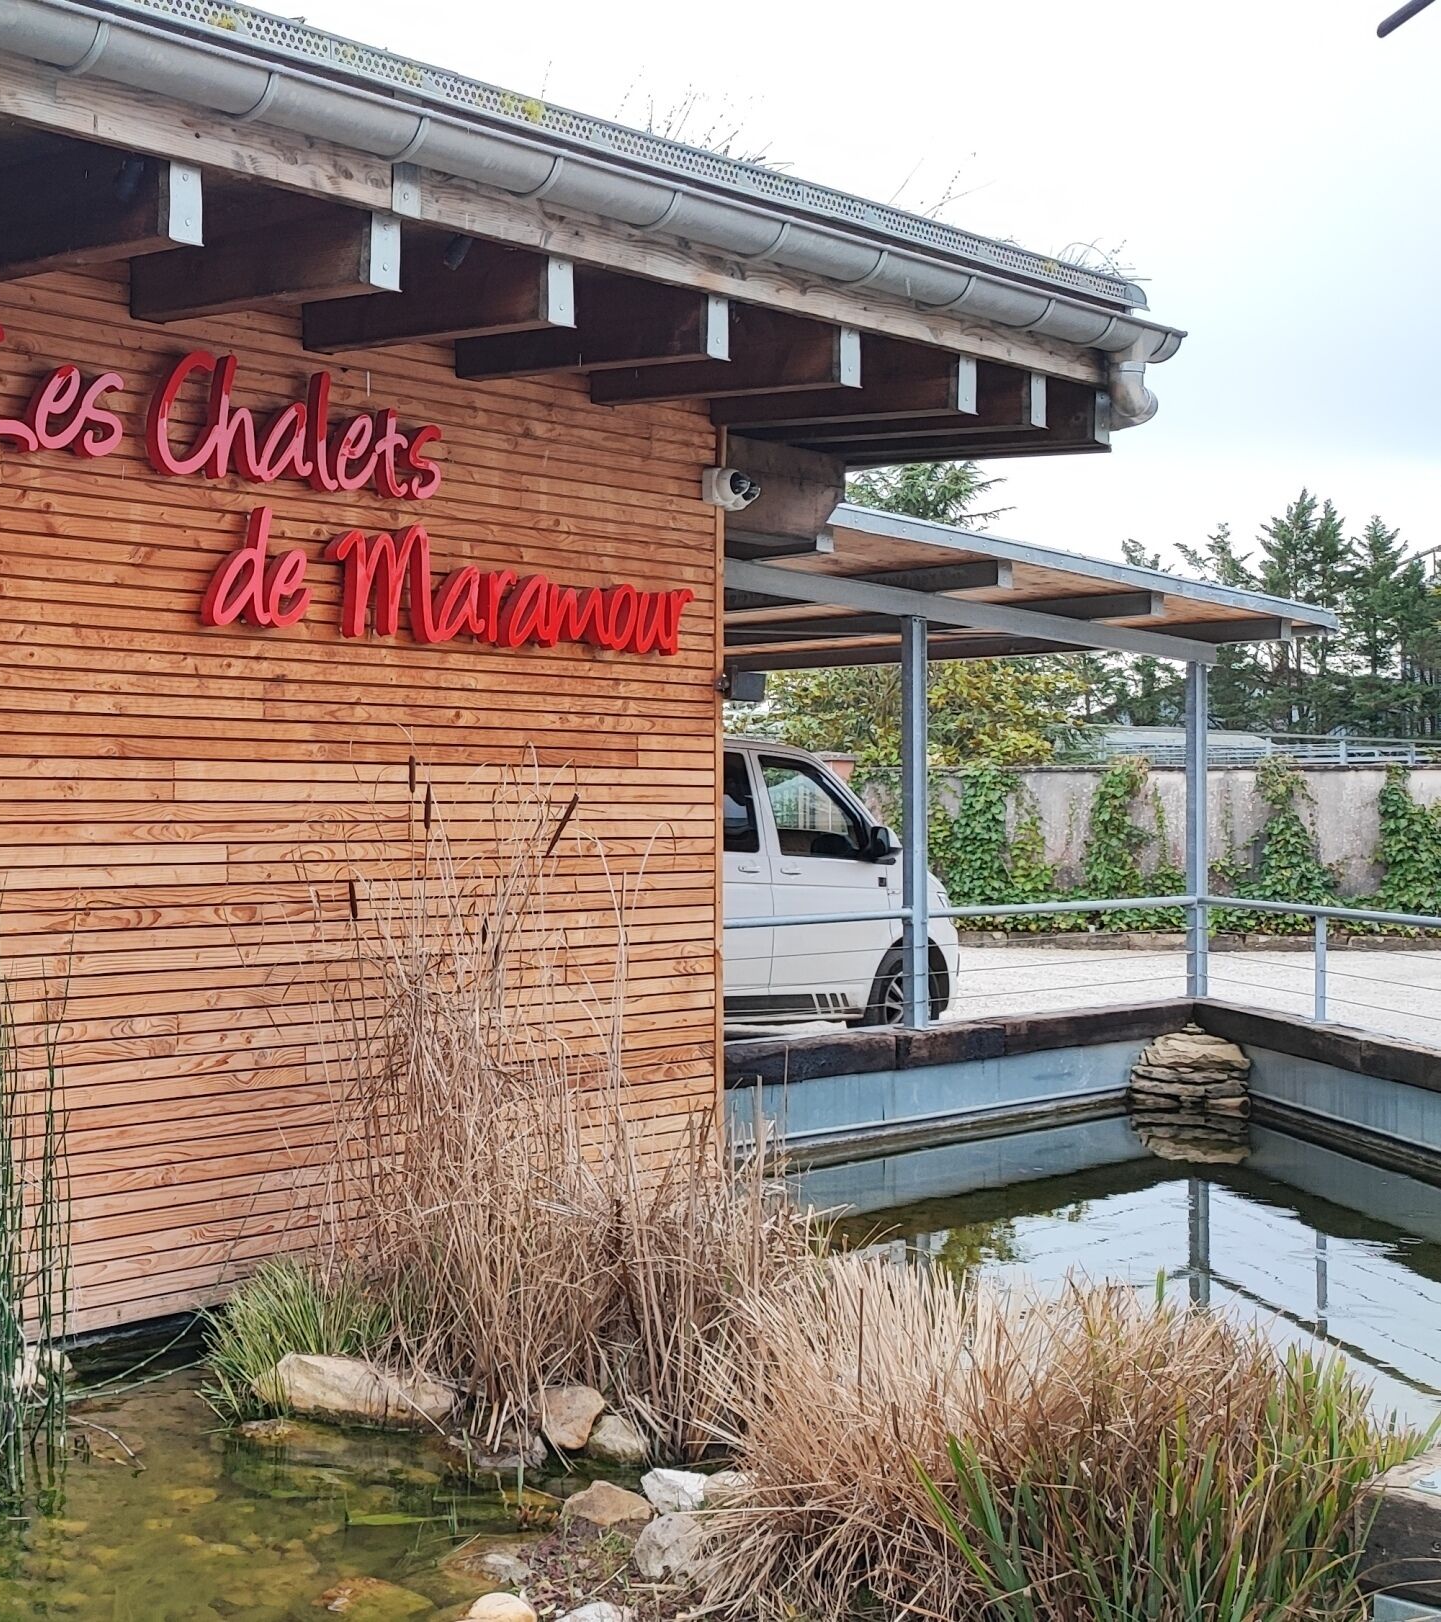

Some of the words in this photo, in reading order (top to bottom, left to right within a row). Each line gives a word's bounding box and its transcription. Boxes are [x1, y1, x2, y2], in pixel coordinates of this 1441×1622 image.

[146, 350, 442, 500] Chalets
[201, 506, 313, 628] de
[324, 523, 695, 656] Maramour
